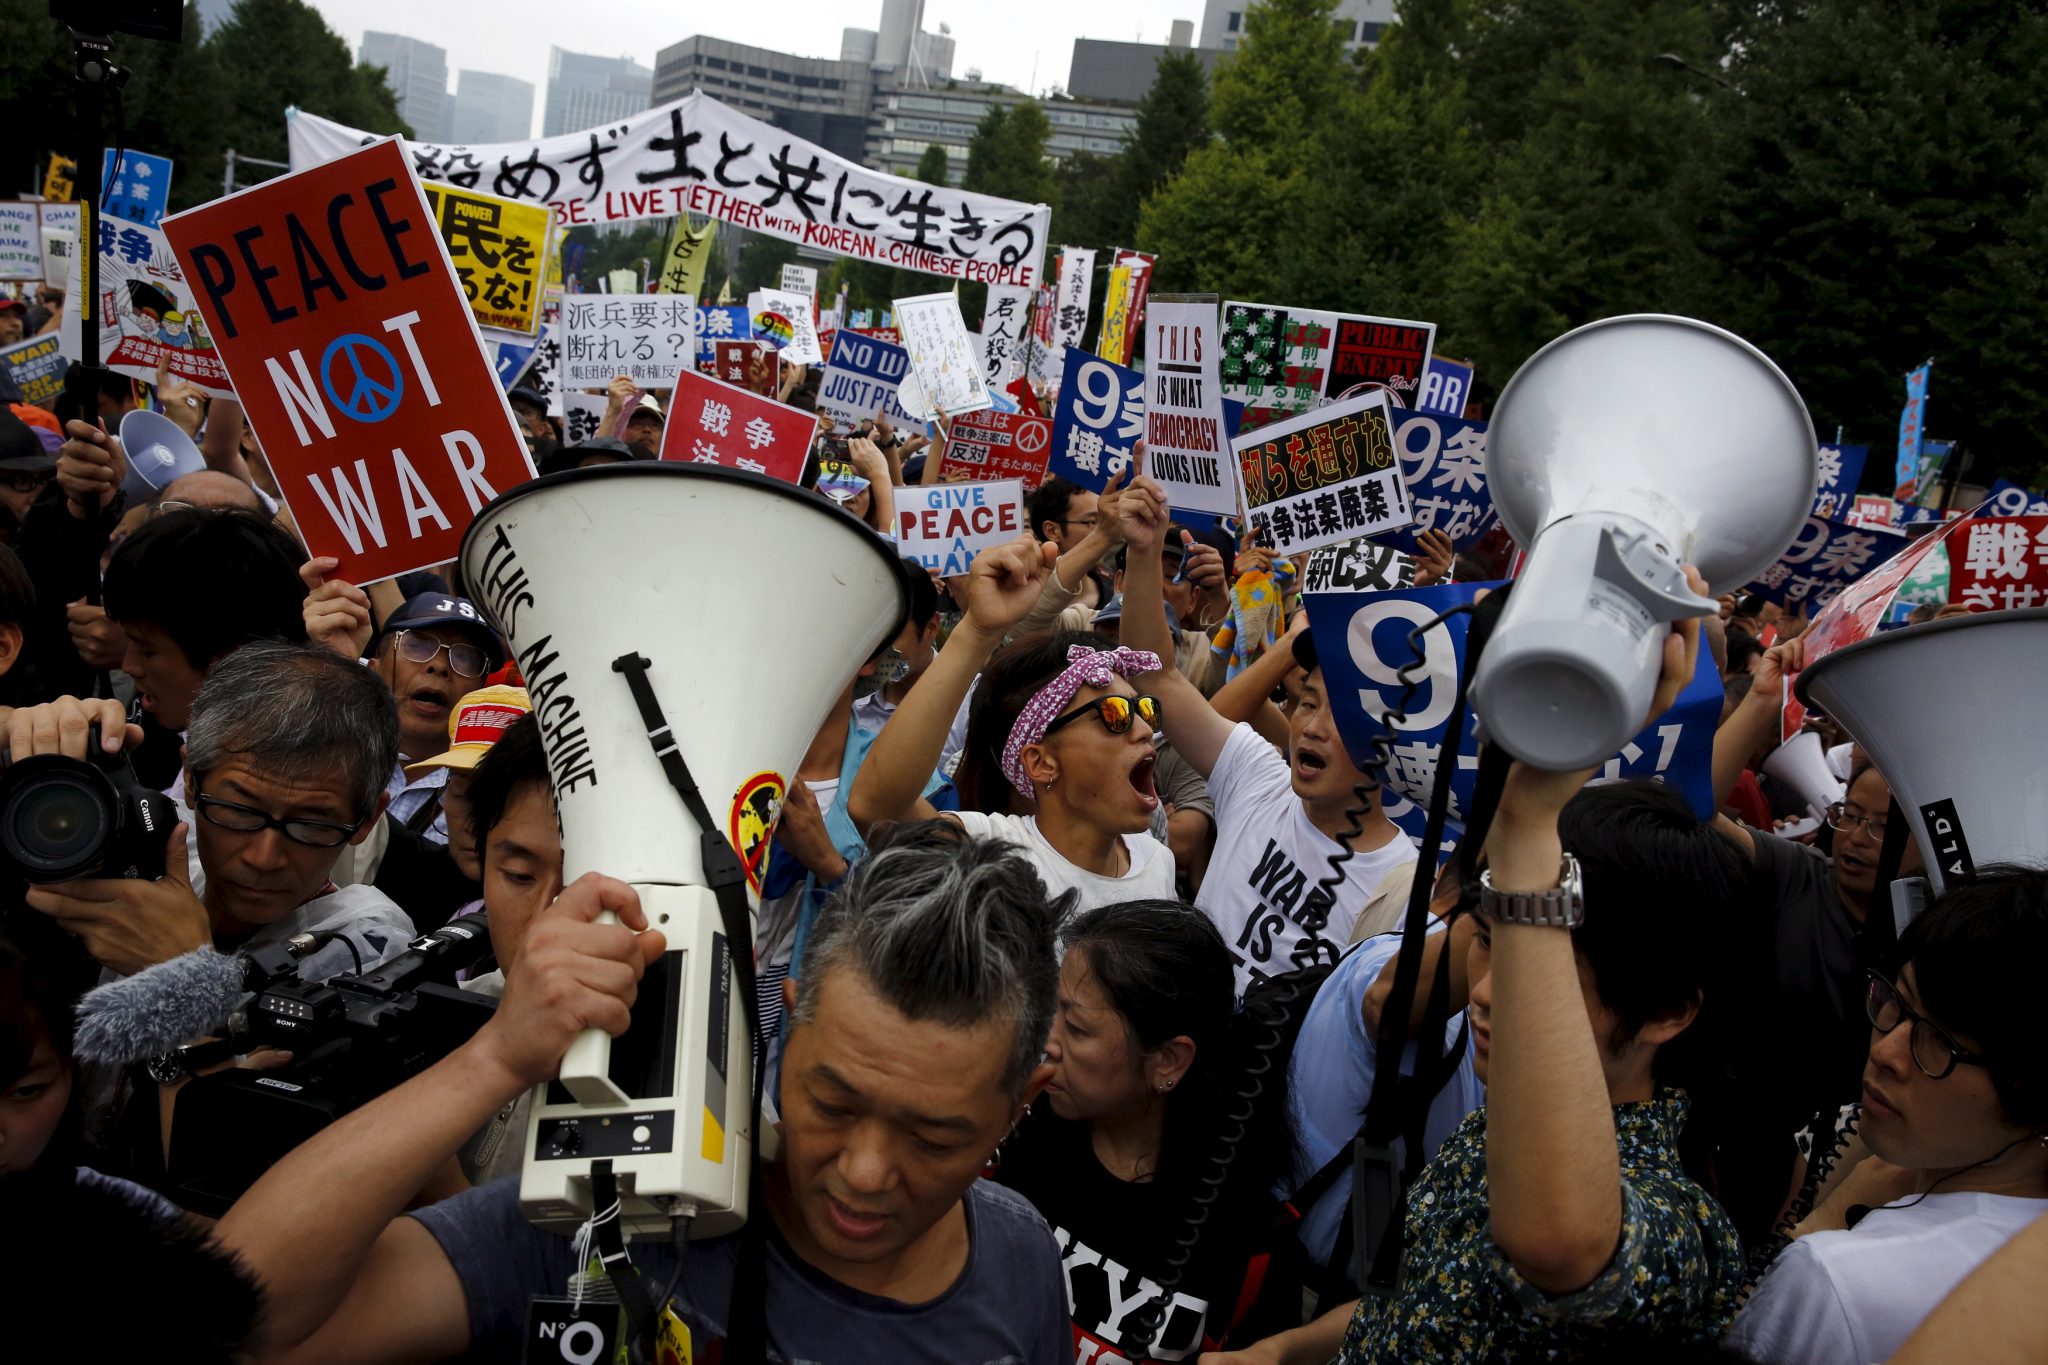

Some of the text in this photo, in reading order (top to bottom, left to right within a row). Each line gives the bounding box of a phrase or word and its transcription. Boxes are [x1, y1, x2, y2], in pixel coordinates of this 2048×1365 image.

[454, 201, 493, 222] POWER
[0, 223, 21, 233] HE
[422, 189, 535, 275] 民を
[605, 189, 664, 221] LIVE
[765, 214, 801, 235] WITH
[803, 220, 876, 259] KOREAN
[889, 241, 962, 277] CHINESE
[965, 258, 1034, 287] PEOPLE
[188, 178, 431, 339] PEACE
[567, 299, 690, 330] 派兵要求
[7, 338, 58, 365] WAR!
[567, 333, 686, 362] 断れる？
[1158, 325, 1203, 363] THIS
[1340, 321, 1427, 350] PUBLIC
[835, 337, 873, 369] NO
[1334, 352, 1420, 381] ENEMY
[824, 374, 871, 406] JUST
[1157, 375, 1203, 409] IS WHAT
[1389, 374, 1419, 391] No.1
[699, 398, 776, 450] 戦争
[953, 426, 1011, 445] 戦争法案に
[1148, 411, 1219, 453] DEMOCRACY
[949, 442, 1043, 473] 反対 するために
[1150, 453, 1222, 488] LOOKS LIKE
[1240, 411, 1393, 508] 奴らを通すな
[1395, 416, 1487, 494] 9条
[307, 429, 499, 556] WAR
[927, 487, 986, 510] GIVE
[900, 502, 1017, 541] PEACE
[1408, 495, 1496, 541] すな!
[1861, 503, 1887, 517] WAR
[952, 537, 966, 552] A
[1961, 582, 2048, 614] させ
[480, 523, 597, 801] THIS MACHINE
[1347, 599, 1458, 732] 9
[139, 799, 155, 832] Canon
[1235, 901, 1286, 964] IS
[275, 1018, 297, 1028] SONY
